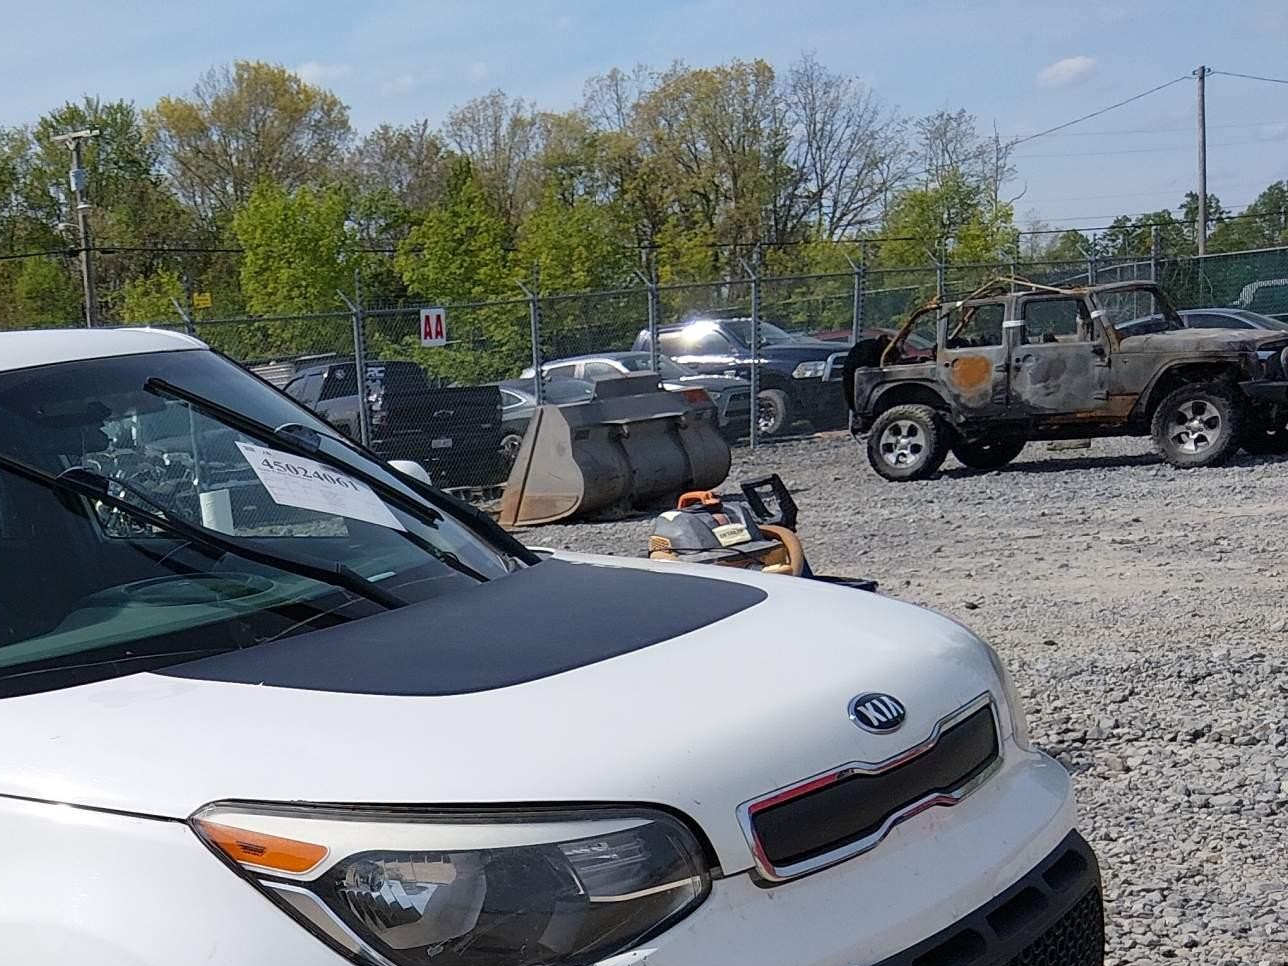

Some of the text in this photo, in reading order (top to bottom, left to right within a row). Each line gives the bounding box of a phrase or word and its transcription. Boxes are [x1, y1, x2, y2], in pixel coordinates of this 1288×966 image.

[423, 314, 444, 340] AA
[260, 457, 361, 492] 45024061
[856, 695, 905, 727] KIA
